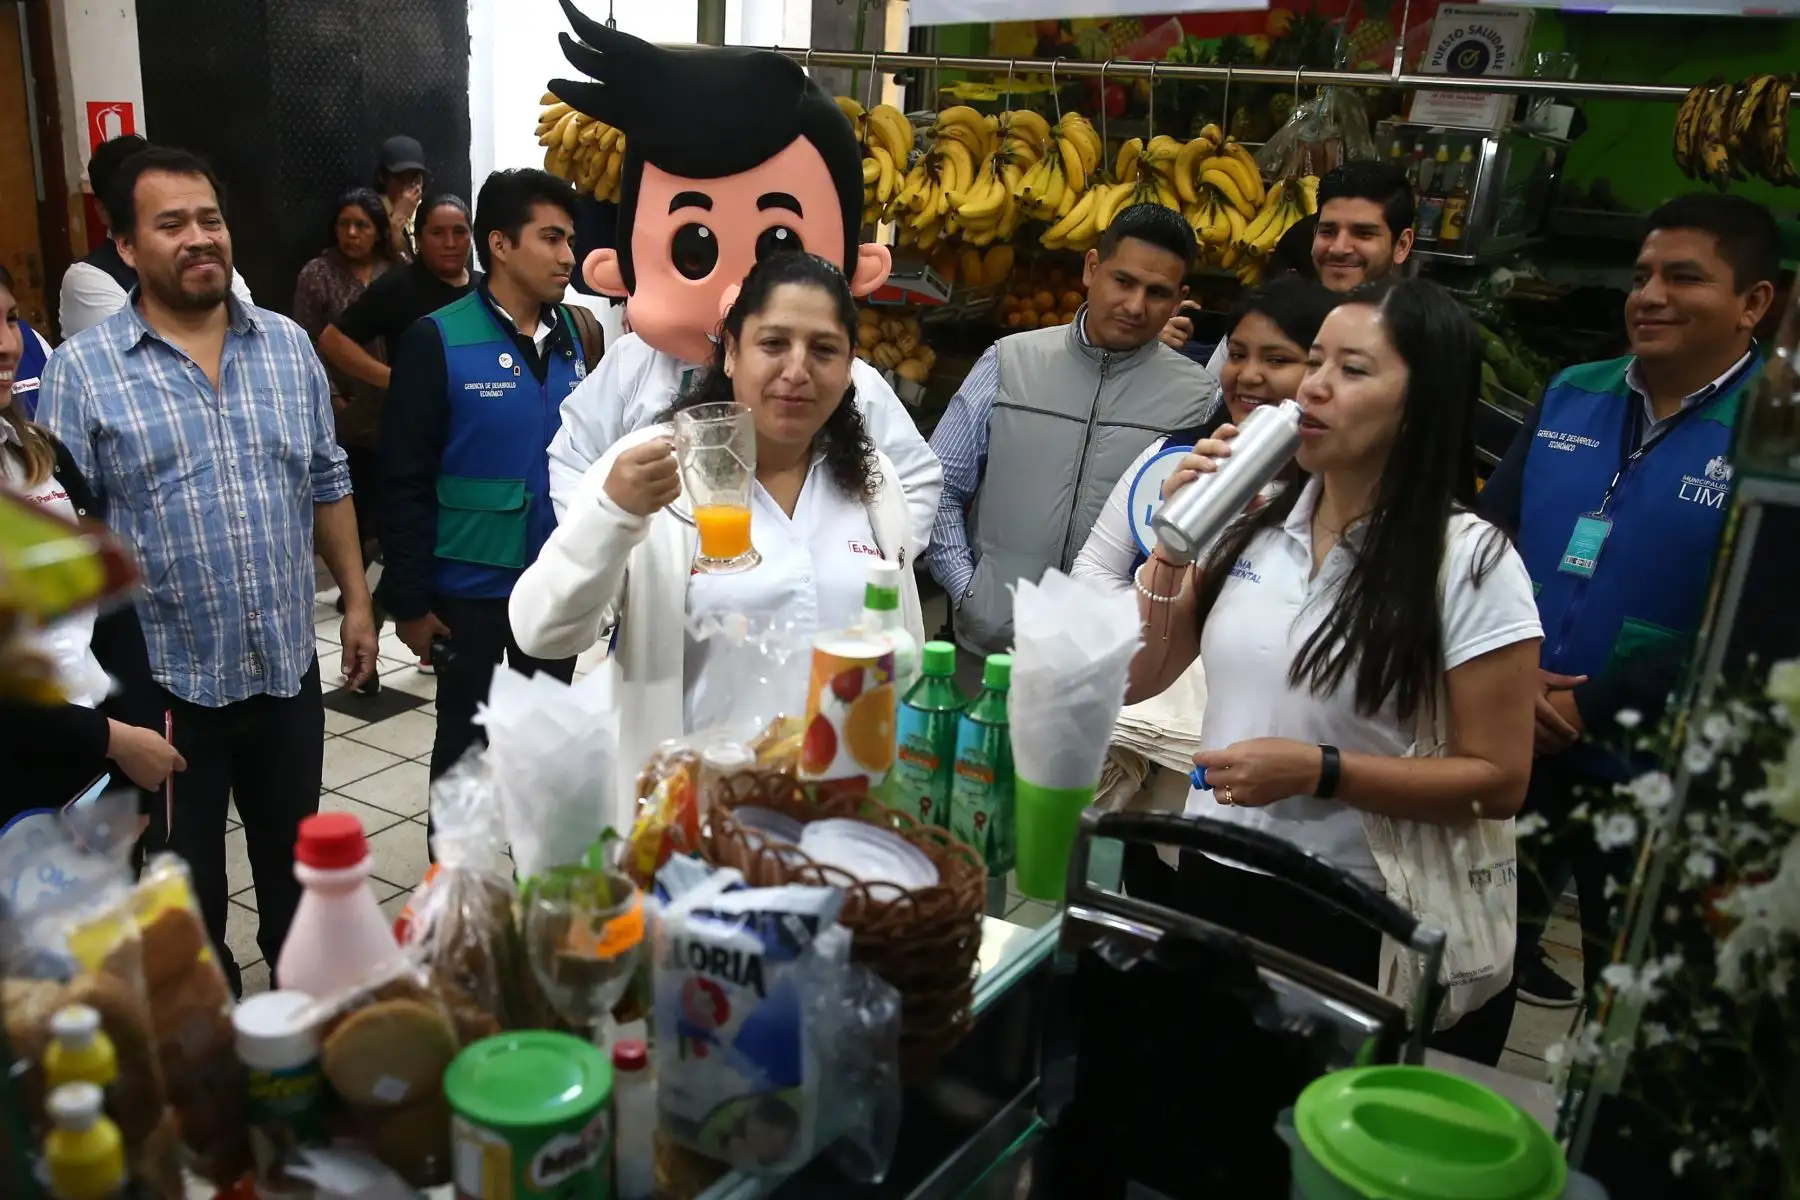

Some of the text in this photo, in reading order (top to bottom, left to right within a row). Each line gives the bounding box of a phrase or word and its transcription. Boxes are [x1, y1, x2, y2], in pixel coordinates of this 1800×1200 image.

[1431, 24, 1506, 72] PUESTO SALUDABLE
[464, 382, 485, 390] GERENCIA
[492, 381, 517, 389] DESARROLLO
[1537, 429, 1600, 448] GERENCIA DE DESARROLLO
[1682, 474, 1729, 491] MUNICIPALID
[1678, 483, 1727, 510] LIM
[662, 934, 768, 1000] LORIA
